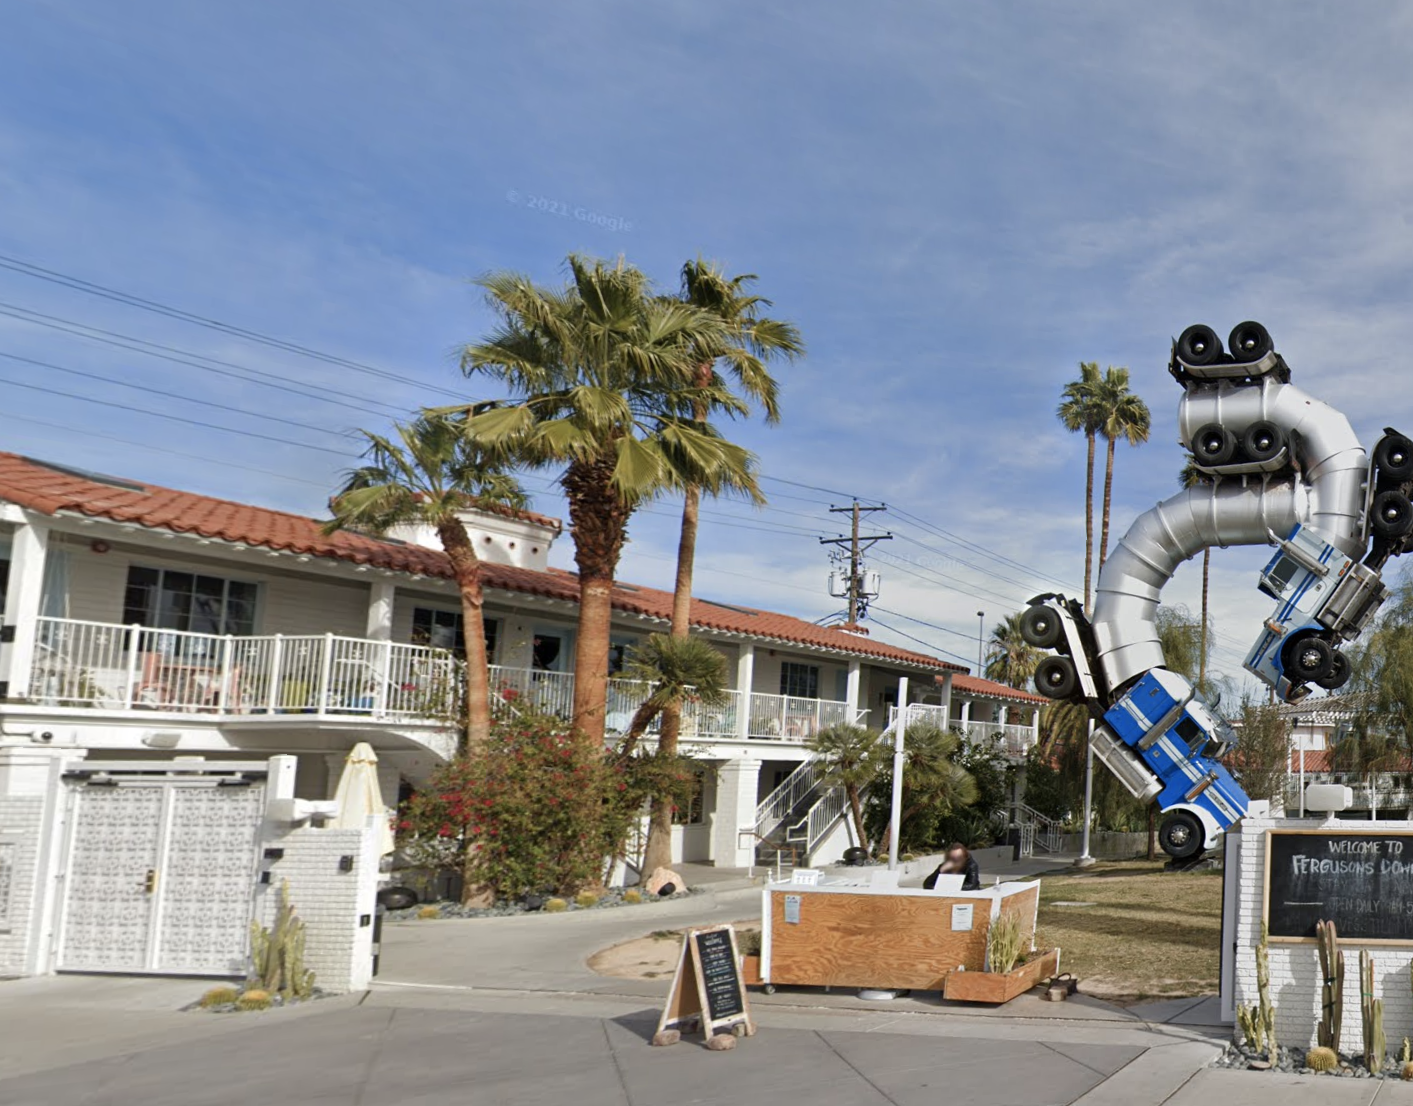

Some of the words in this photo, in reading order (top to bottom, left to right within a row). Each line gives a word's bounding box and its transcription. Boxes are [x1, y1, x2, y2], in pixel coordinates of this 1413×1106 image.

[1328, 840, 1382, 854] WELCOME
[1385, 840, 1404, 854] TO
[1292, 854, 1375, 876] FERGUSONS
